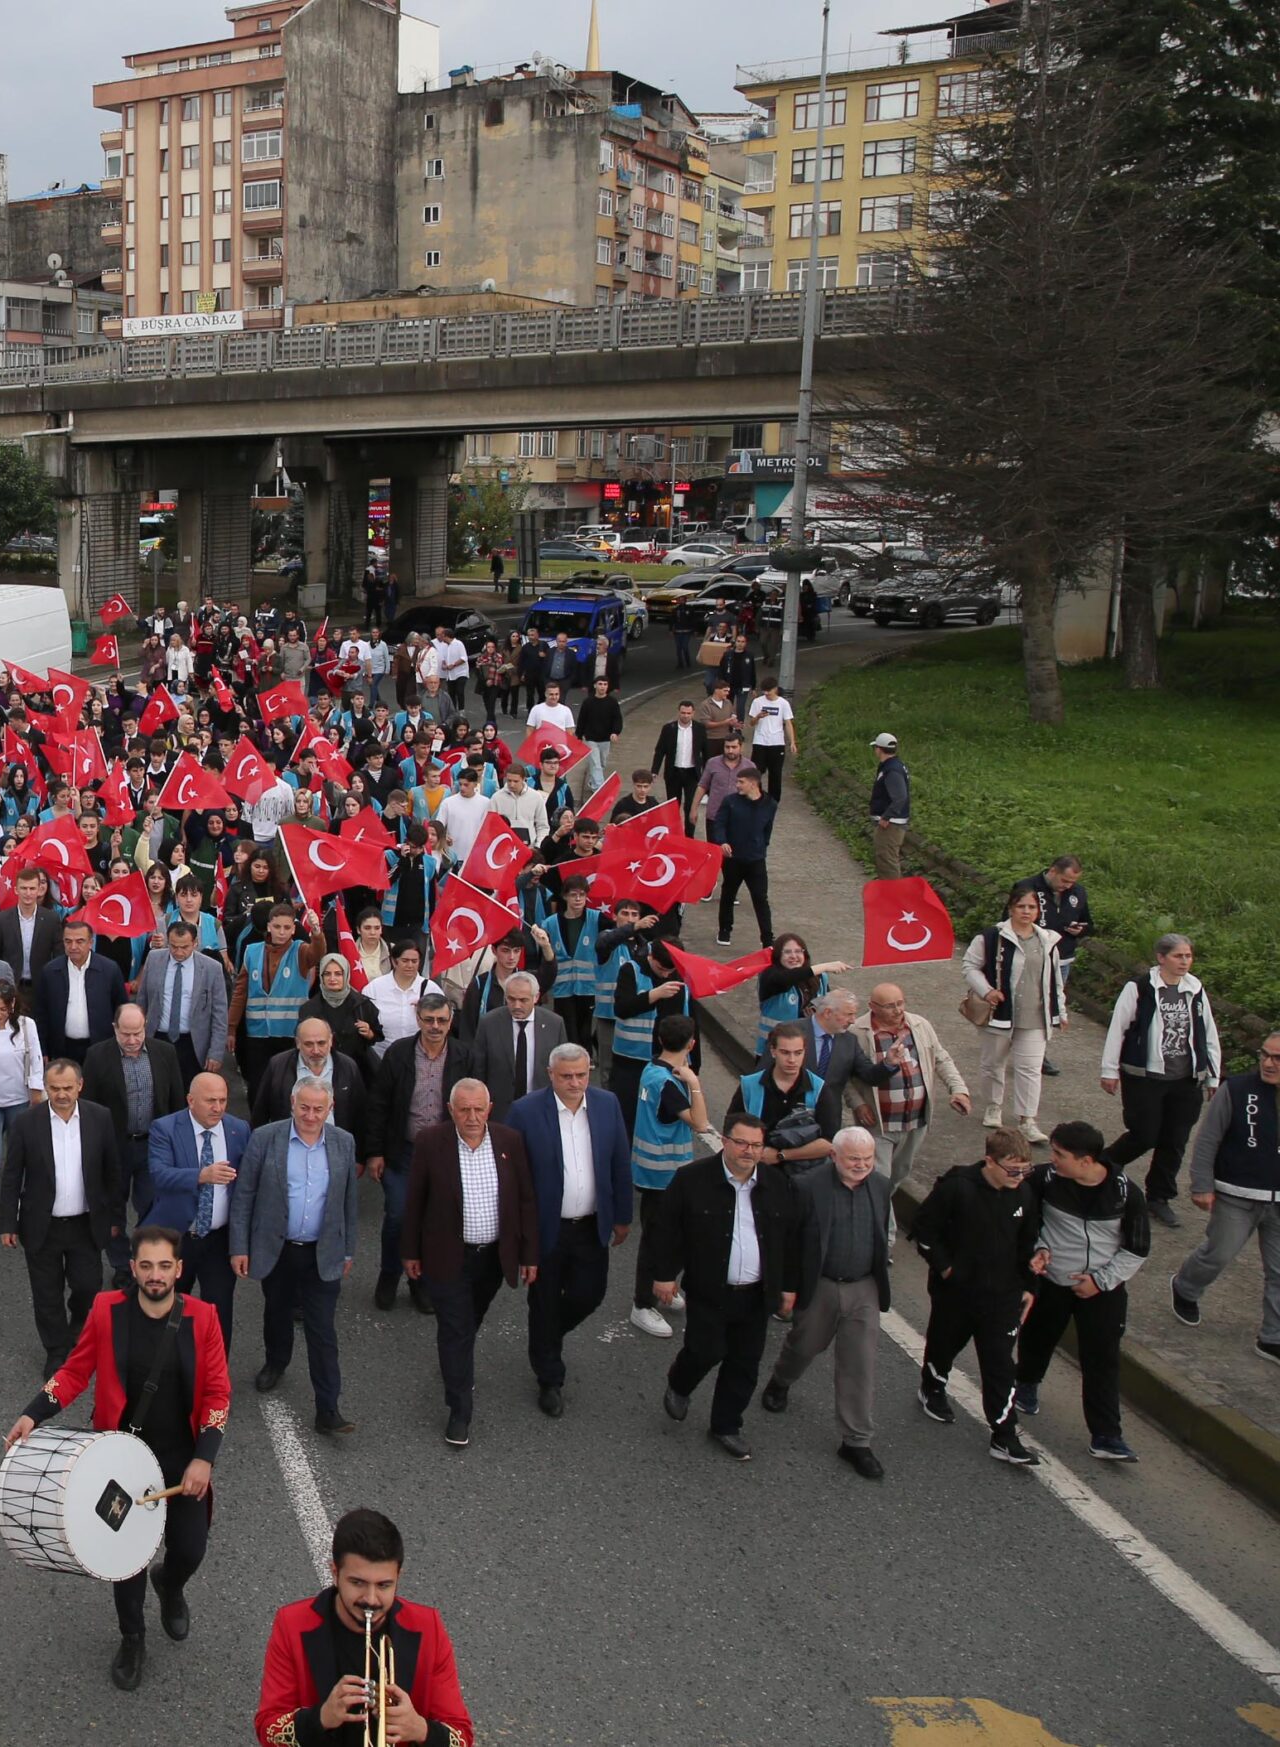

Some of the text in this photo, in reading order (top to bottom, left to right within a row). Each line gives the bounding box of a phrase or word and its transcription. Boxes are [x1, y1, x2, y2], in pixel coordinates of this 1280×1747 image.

[141, 317, 182, 331] BÜŞRA
[185, 313, 237, 328] CANBAZ
[756, 456, 823, 468] METROOL
